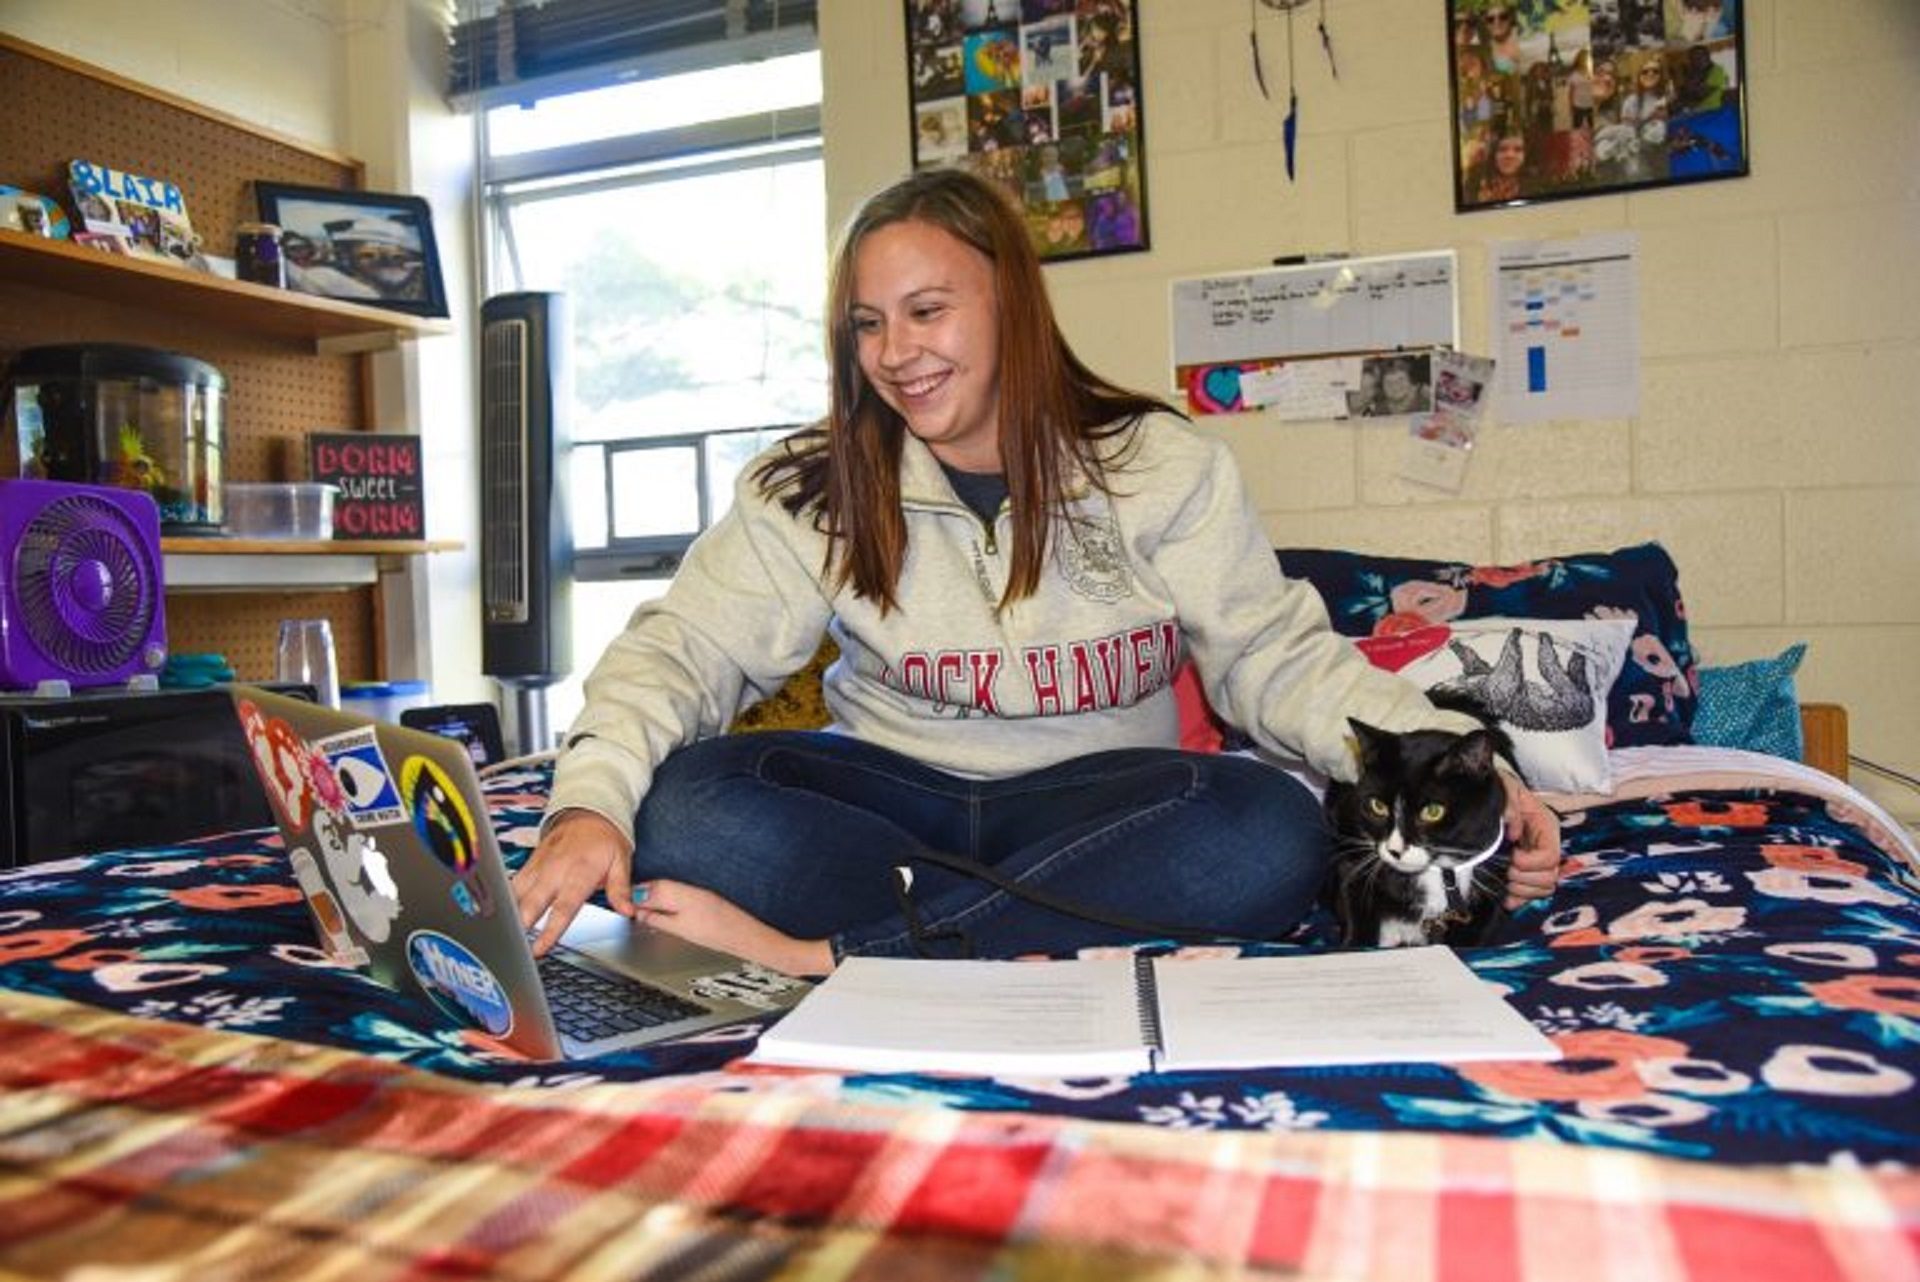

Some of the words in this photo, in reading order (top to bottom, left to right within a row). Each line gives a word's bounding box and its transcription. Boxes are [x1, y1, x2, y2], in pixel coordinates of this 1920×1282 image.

[72, 160, 182, 214] BLAIR
[318, 442, 416, 476] DORM
[339, 476, 396, 499] sweet
[879, 651, 1002, 716] OCK
